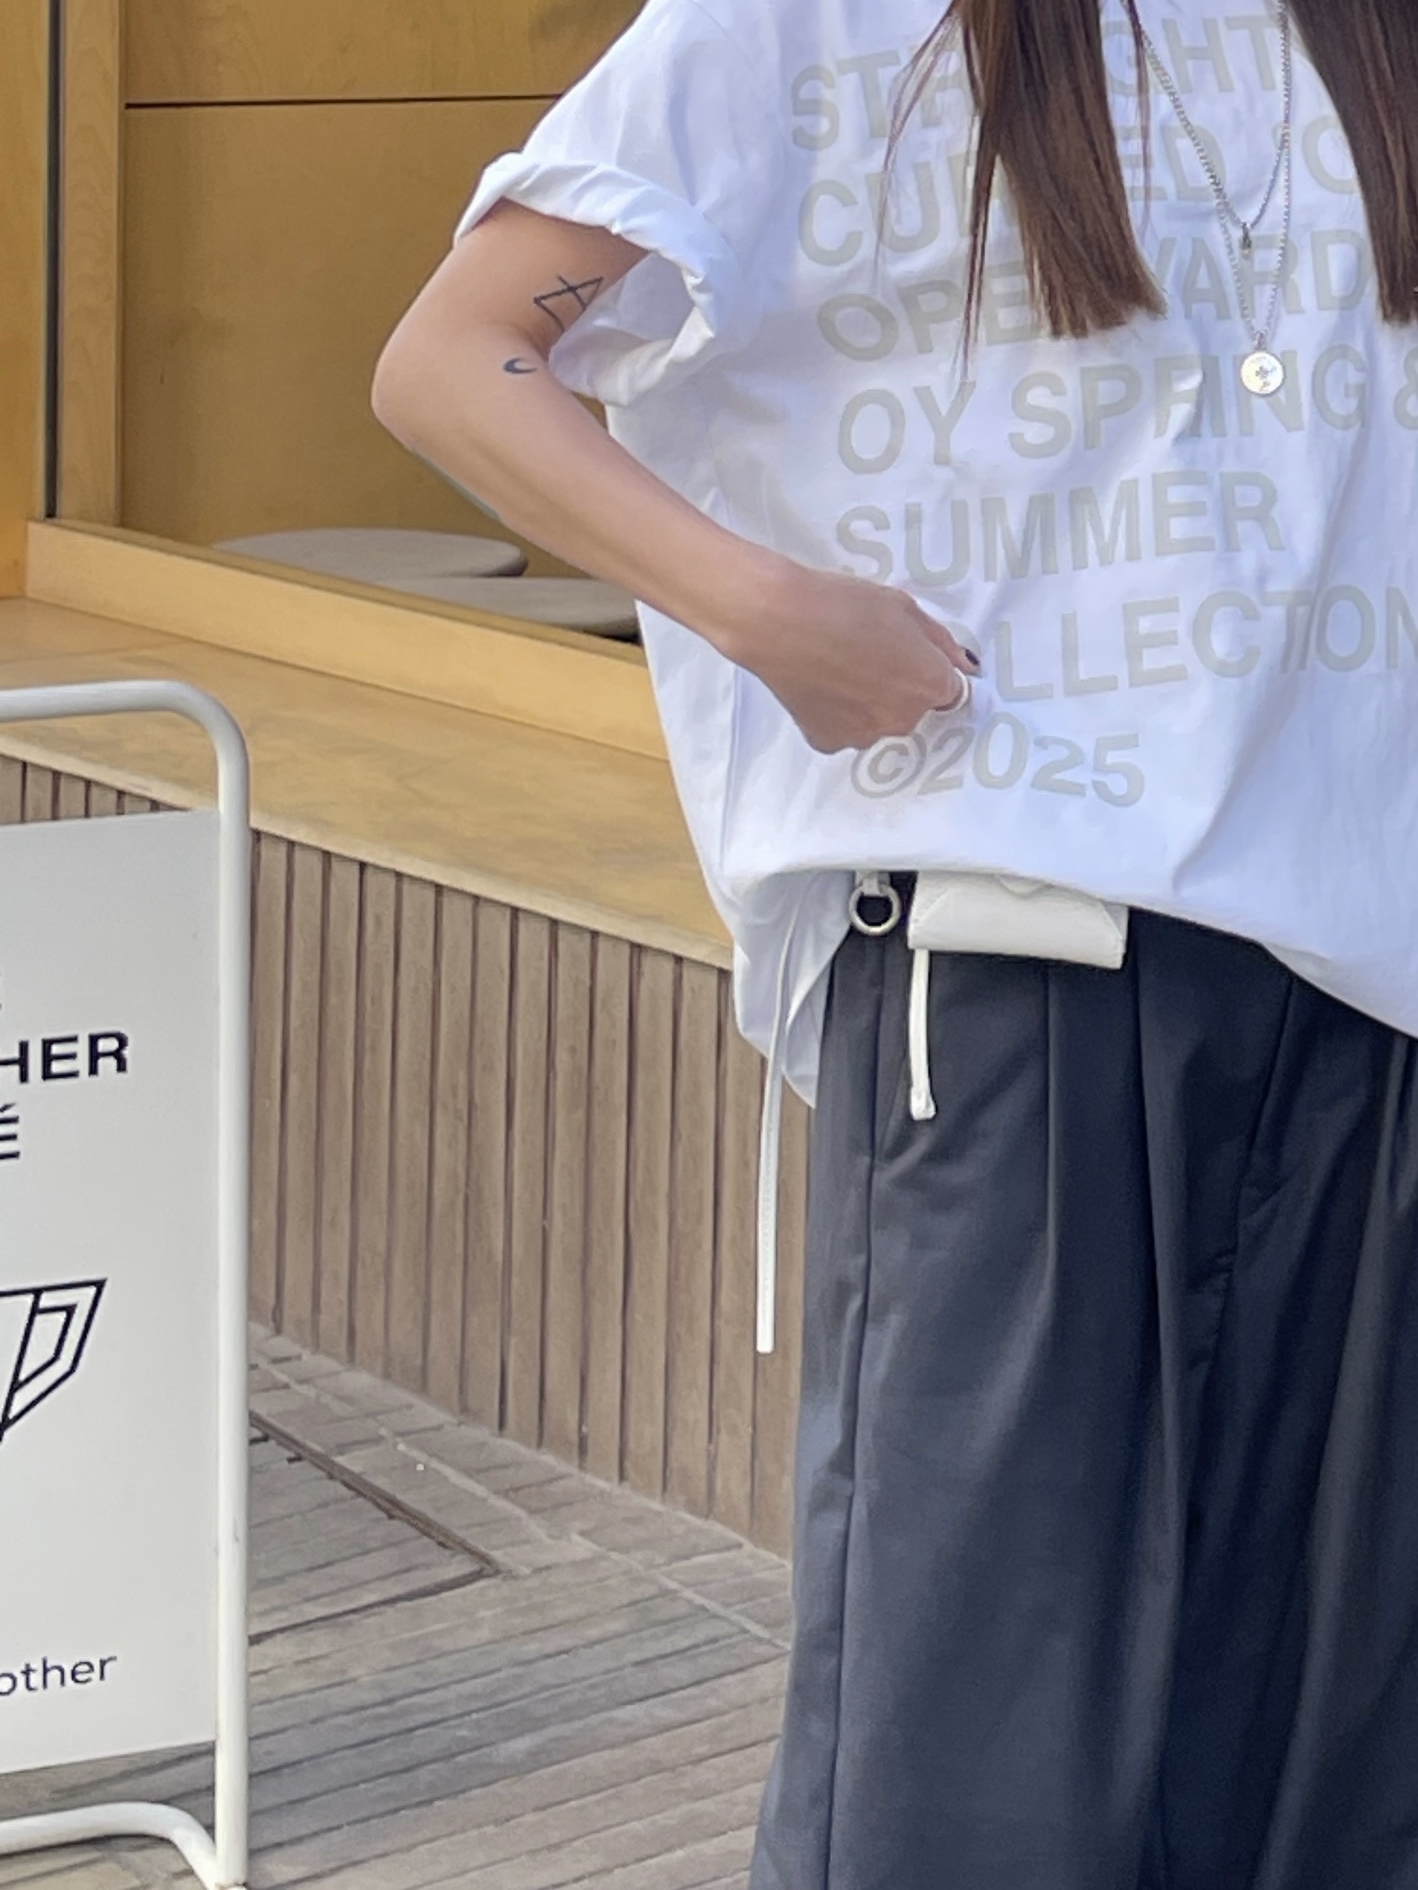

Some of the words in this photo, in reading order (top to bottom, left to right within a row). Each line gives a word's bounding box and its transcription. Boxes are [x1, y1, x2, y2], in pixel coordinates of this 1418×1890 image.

[790, 14, 1287, 151] STRGHT
[837, 379, 977, 475] OY
[1007, 343, 1368, 460] SPRING
[835, 470, 1287, 588] SUMMER
[850, 711, 1146, 808] ©2025
